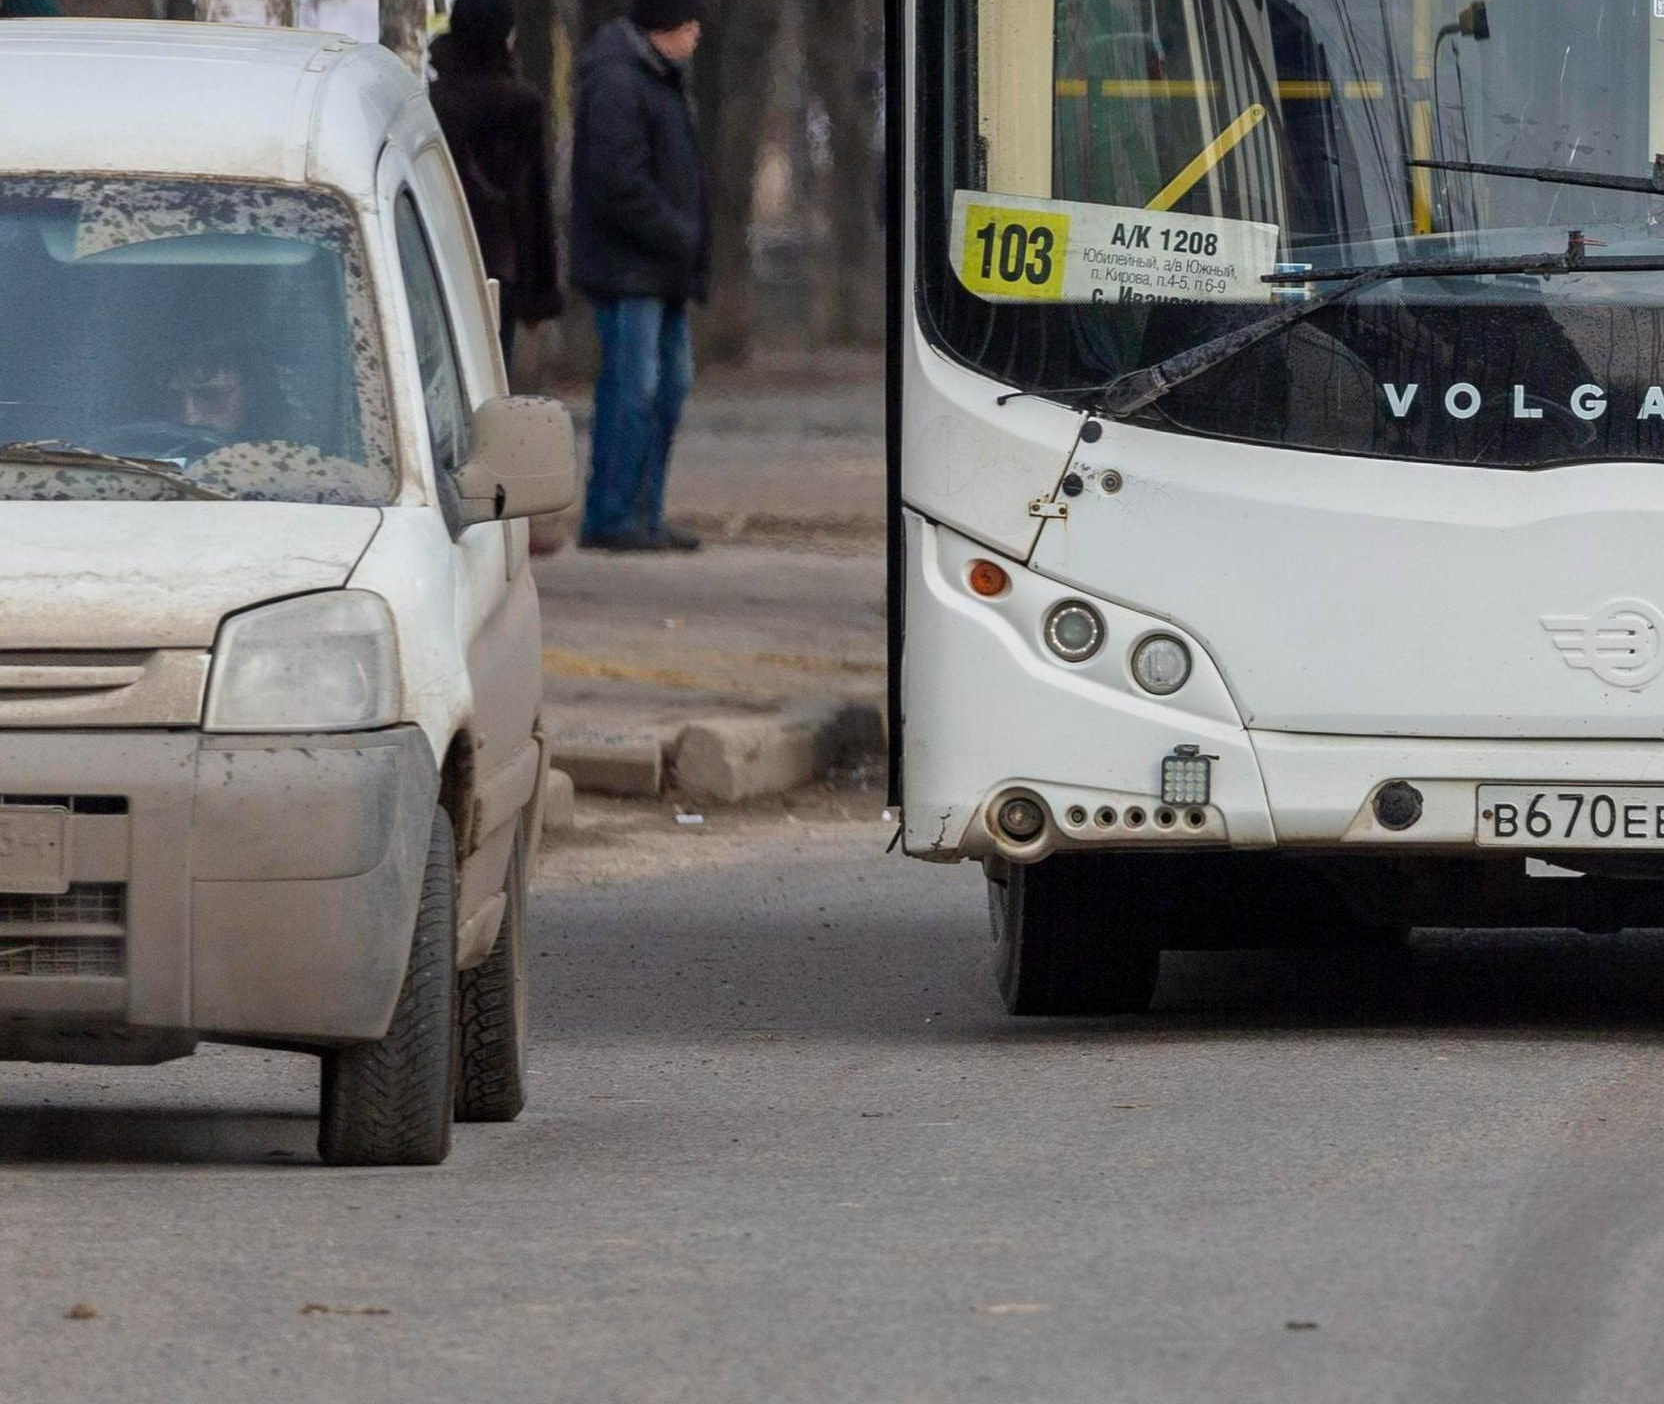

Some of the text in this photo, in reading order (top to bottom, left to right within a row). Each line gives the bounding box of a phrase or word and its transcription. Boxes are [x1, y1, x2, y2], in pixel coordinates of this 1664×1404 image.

[977, 222, 1054, 285] 103
[1111, 223, 1218, 256] А/К 1208
[1083, 247, 1237, 280] Юбилейный, а/в Южный,
[1105, 266, 1152, 287] Кирова,
